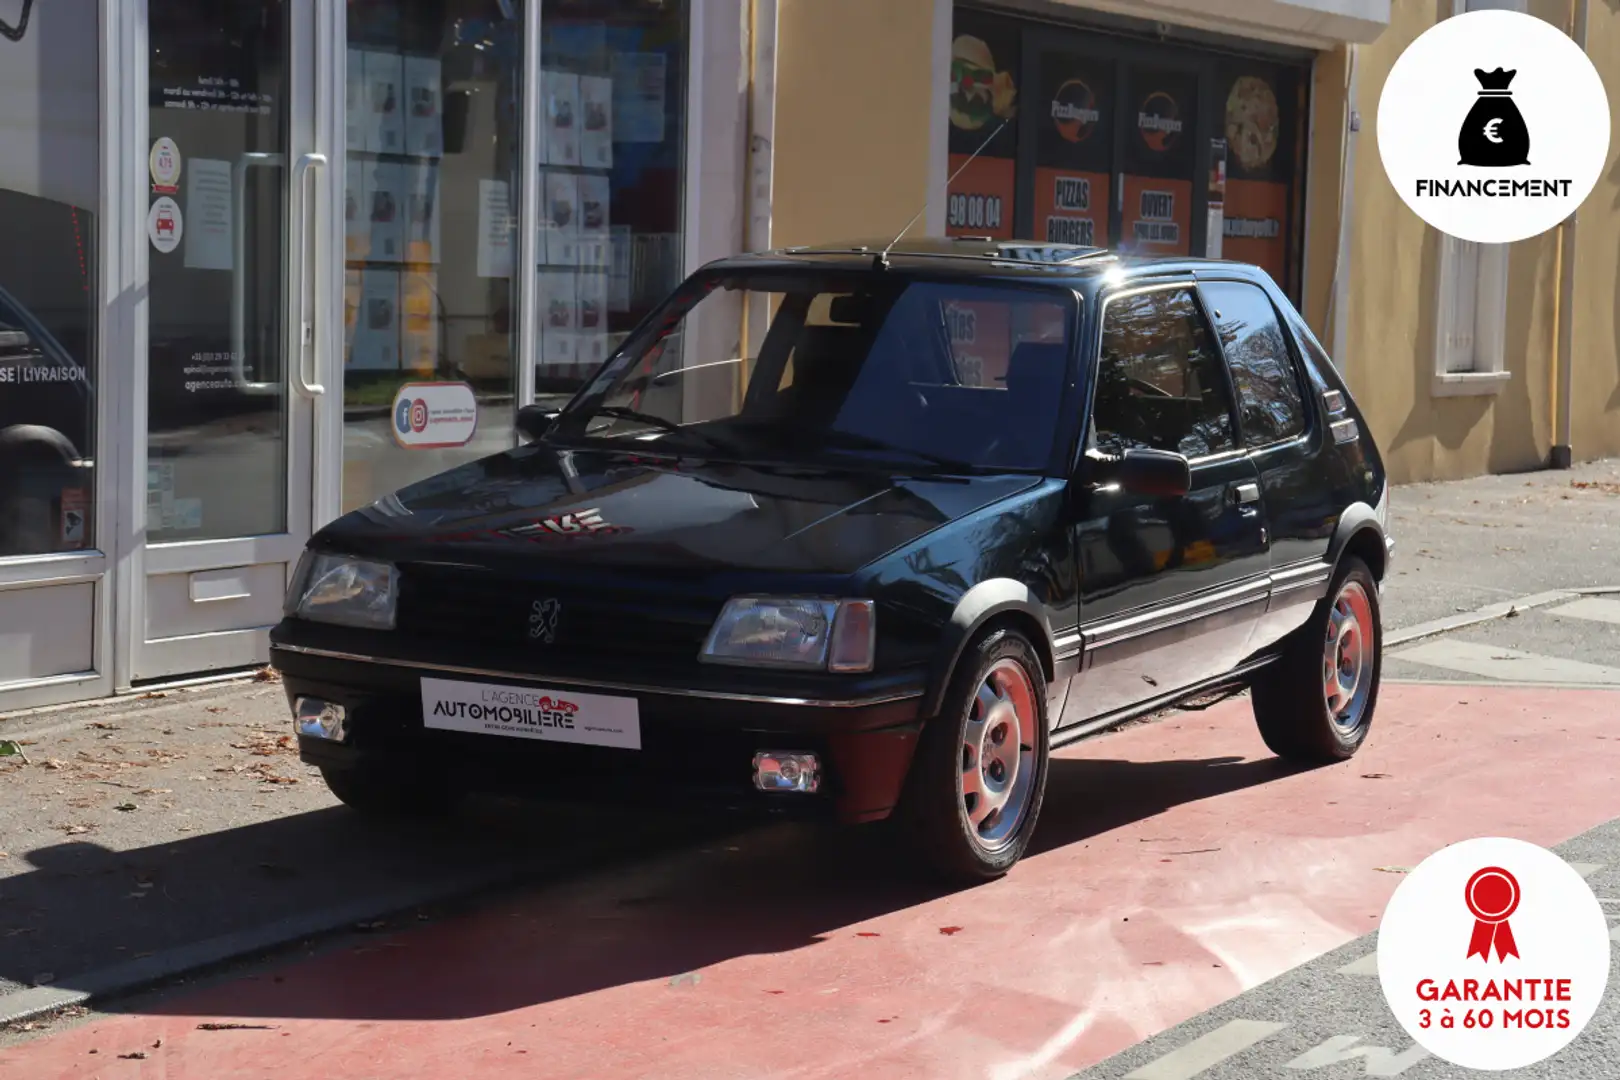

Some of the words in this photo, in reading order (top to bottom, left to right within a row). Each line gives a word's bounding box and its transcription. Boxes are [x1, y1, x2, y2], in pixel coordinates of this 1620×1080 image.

[1055, 178, 1089, 210] PIZZAS
[1140, 190, 1174, 219] OUVERT
[950, 194, 966, 227] 98
[968, 195, 984, 228] 08
[985, 196, 1000, 228] 04
[1047, 216, 1095, 246] BURGERS
[0, 367, 15, 382] SE
[24, 366, 86, 382] LIVRAISON
[481, 689, 540, 707] L'AGENCE
